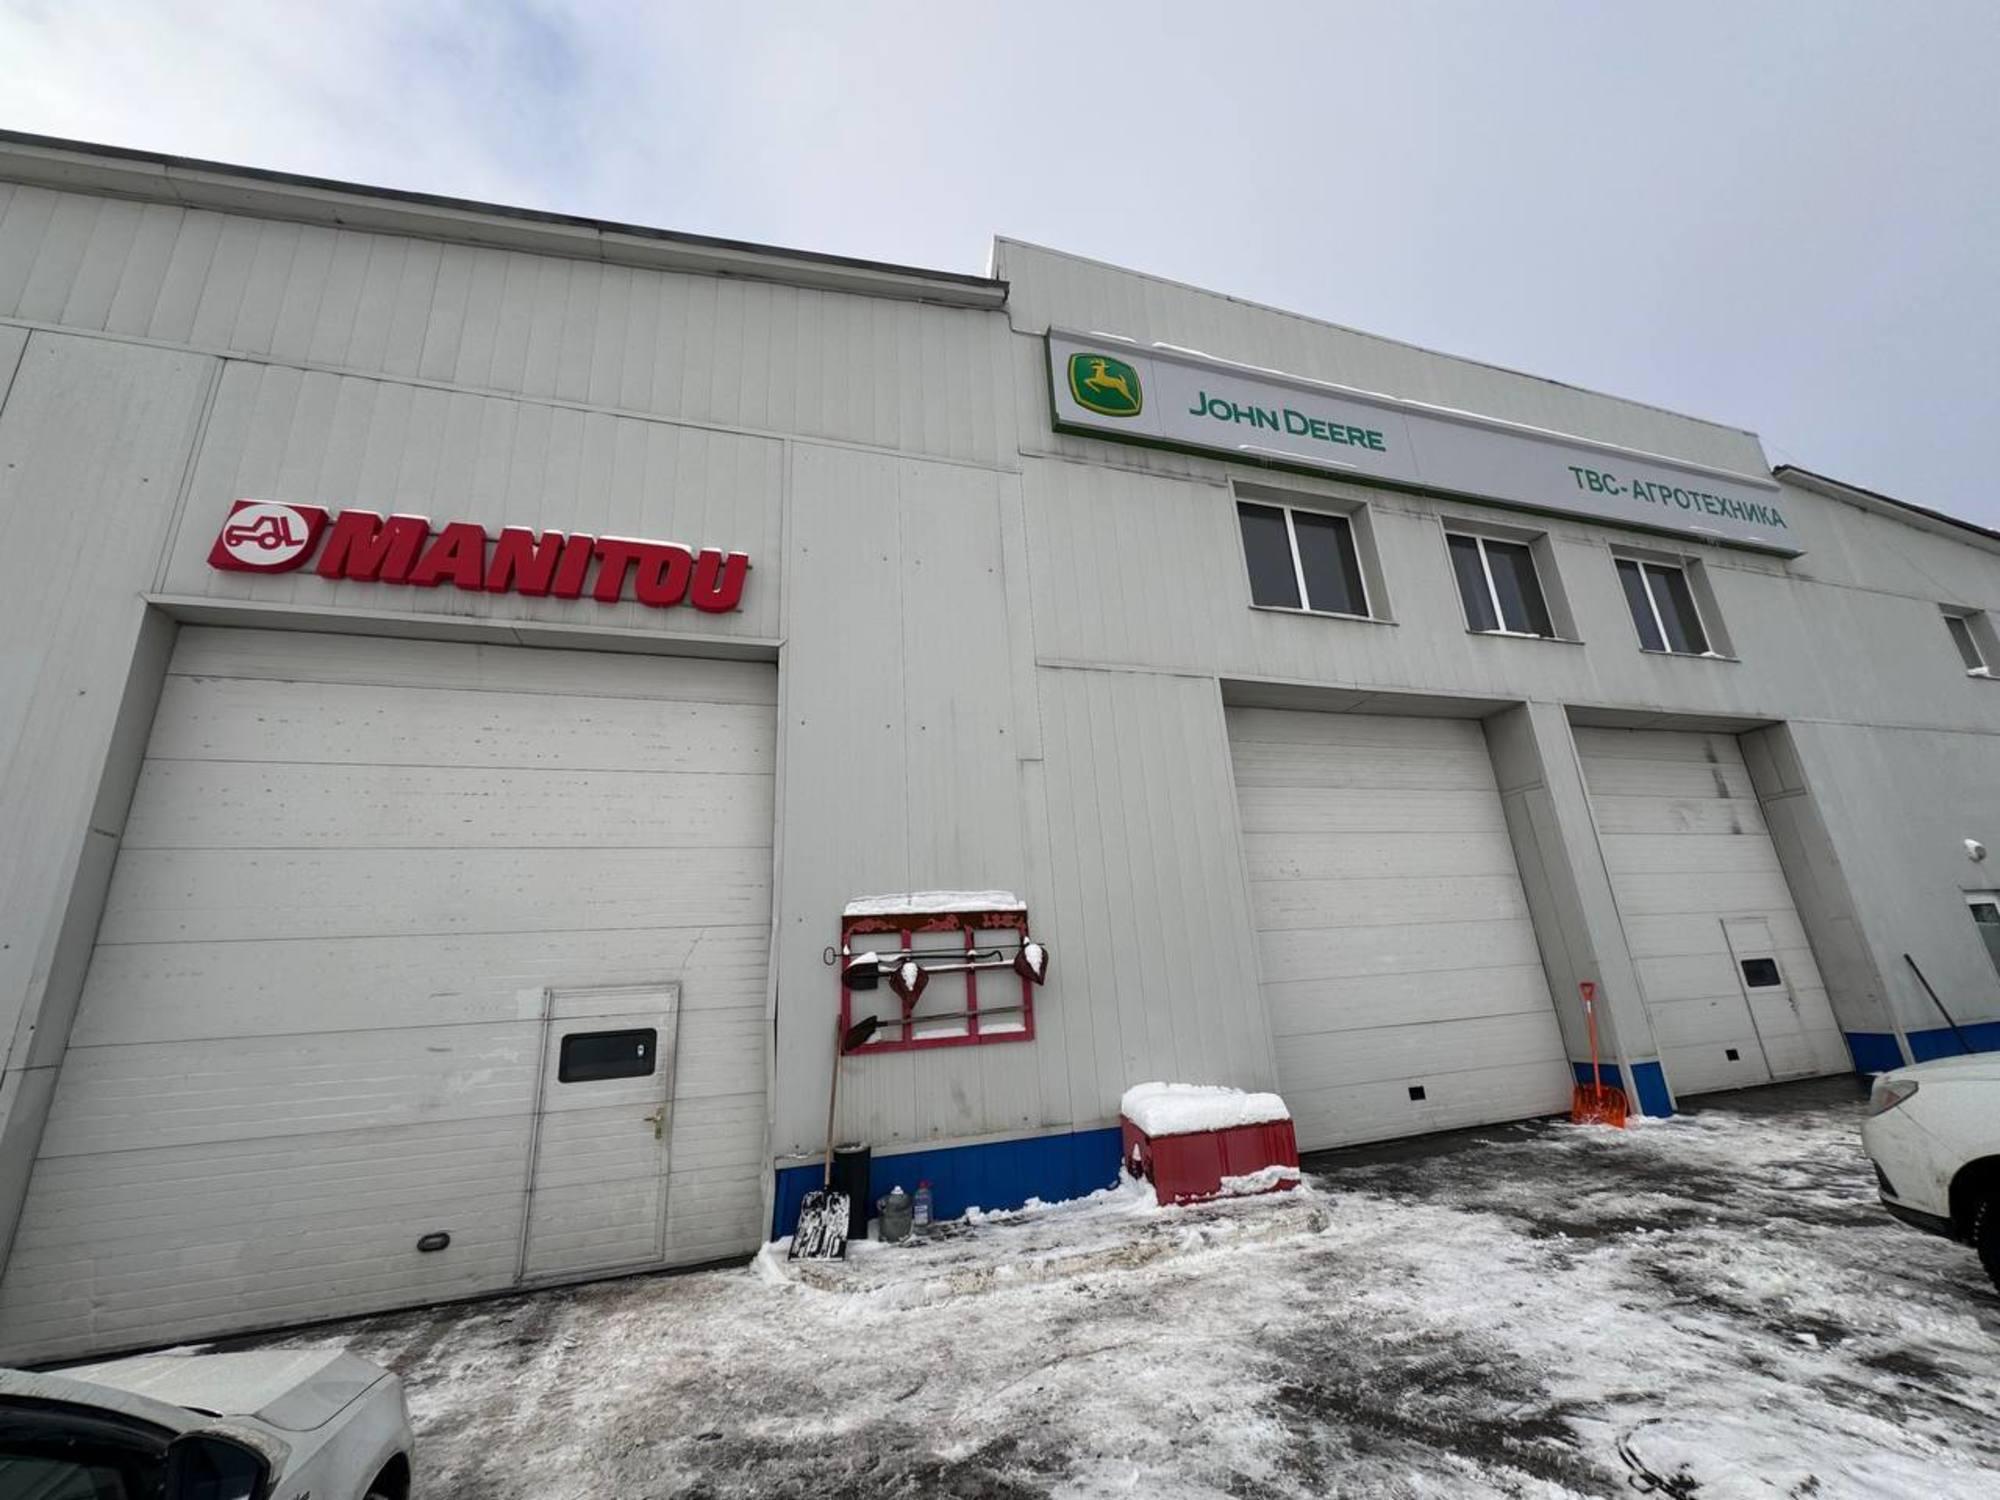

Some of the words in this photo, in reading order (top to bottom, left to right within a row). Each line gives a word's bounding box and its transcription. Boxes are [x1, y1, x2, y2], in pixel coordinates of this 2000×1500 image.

[1189, 392, 1279, 431] JOHN
[1284, 408, 1386, 451] DEERE
[317, 510, 749, 613] MANITOU
